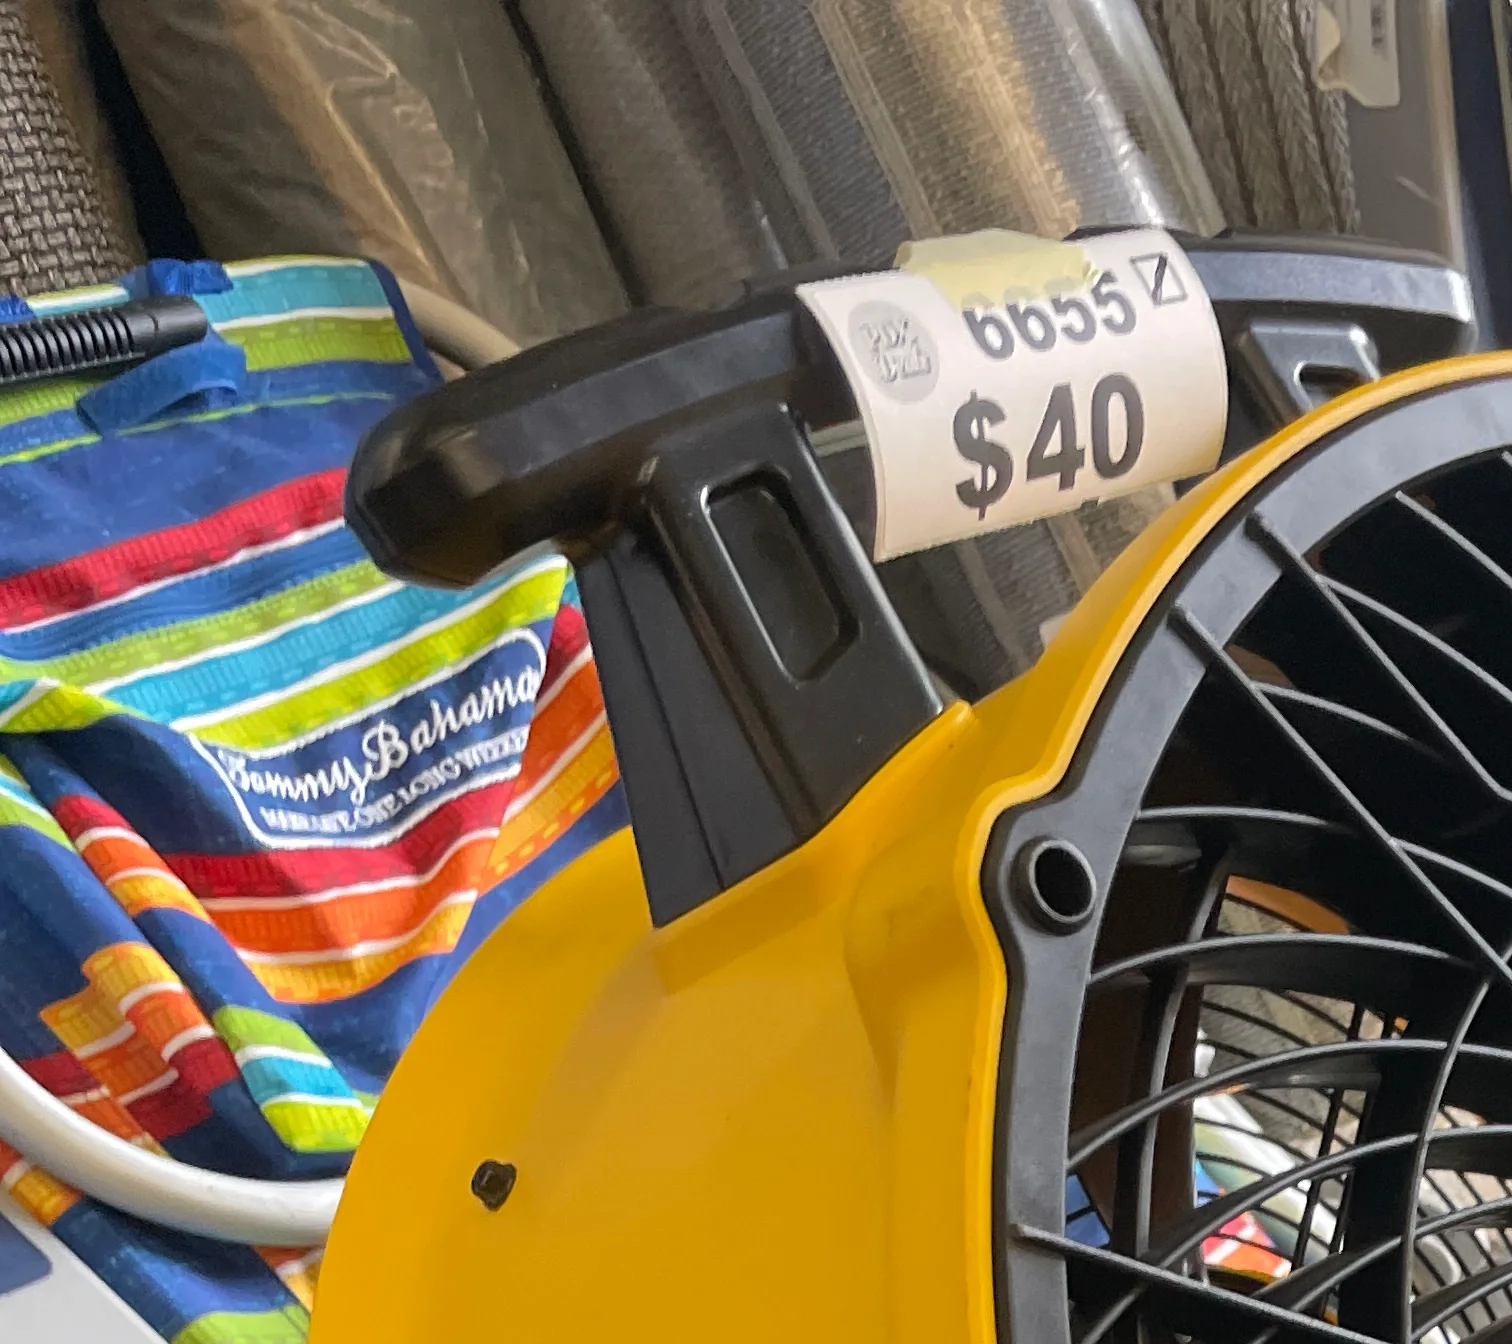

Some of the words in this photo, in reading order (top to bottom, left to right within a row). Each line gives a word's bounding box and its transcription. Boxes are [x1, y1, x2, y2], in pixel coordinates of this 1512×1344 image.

[961, 270, 1137, 361] 6655
[952, 373, 1145, 521] $40
[217, 747, 373, 807] Tommy
[362, 666, 541, 781] Bahama
